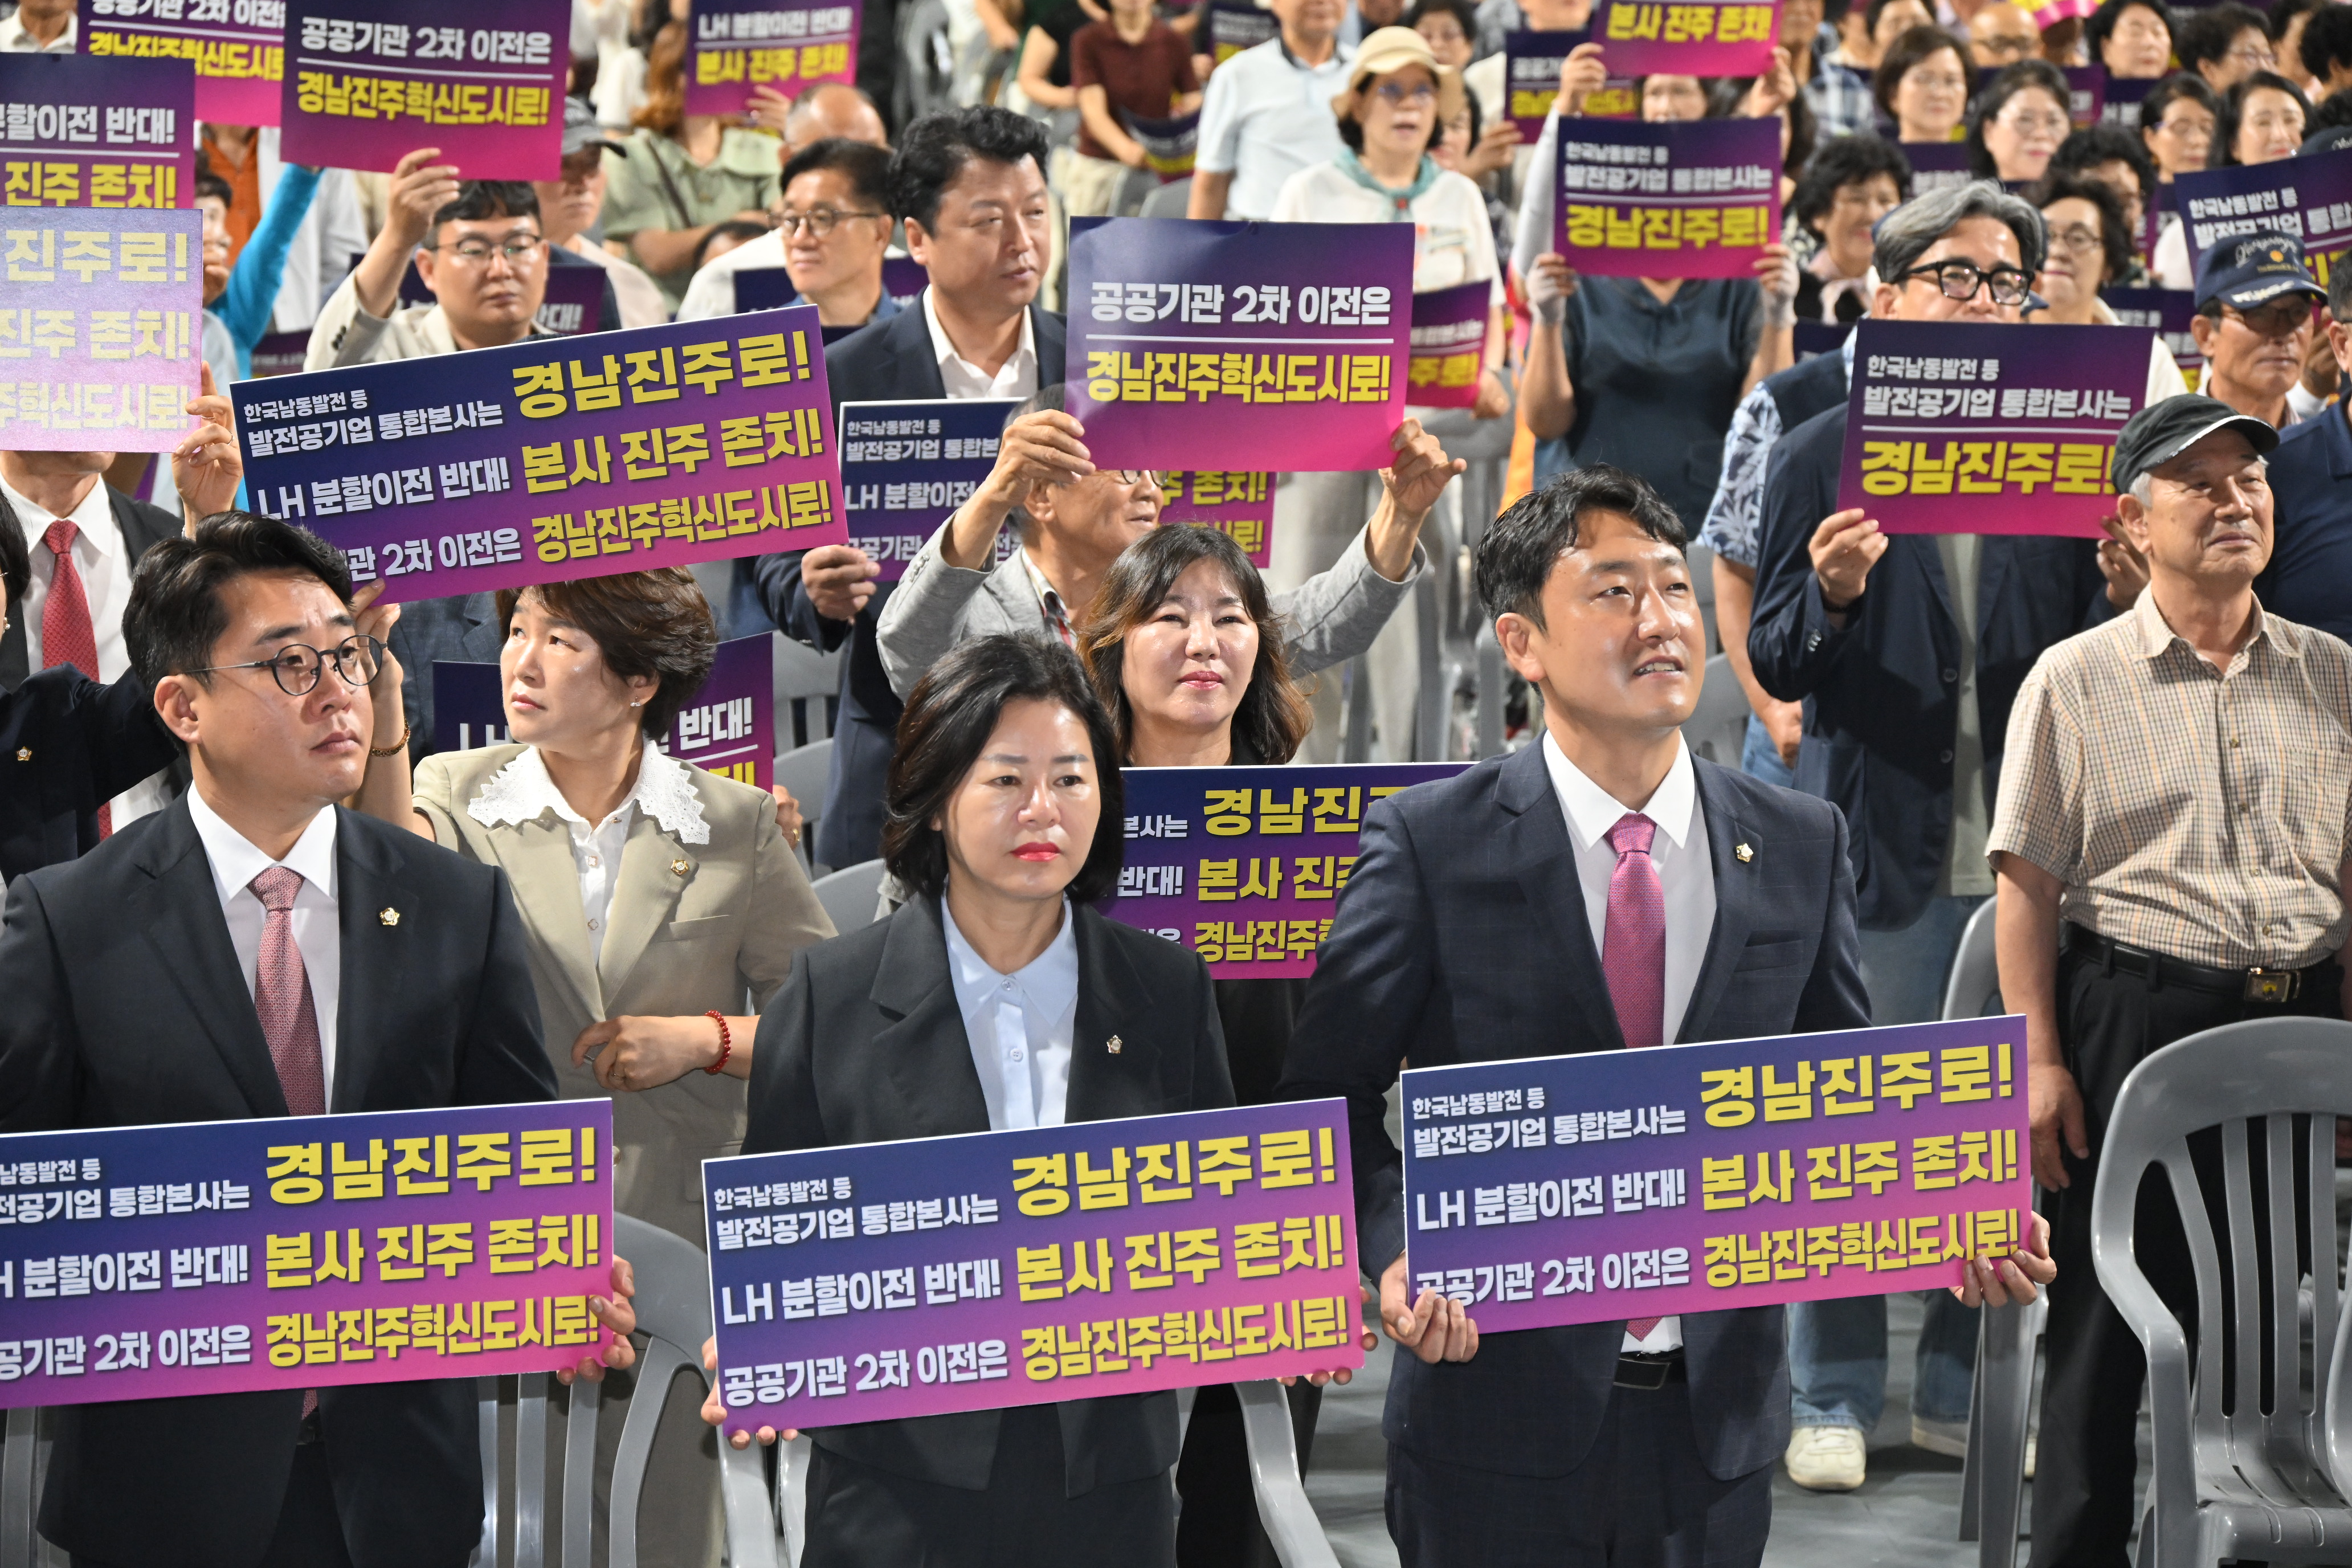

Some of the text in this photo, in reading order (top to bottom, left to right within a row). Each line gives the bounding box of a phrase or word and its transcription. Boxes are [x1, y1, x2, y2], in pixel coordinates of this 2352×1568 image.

[188, 0, 230, 23] 2차
[234, 0, 285, 28] 이전
[90, 32, 284, 80] 경남진주혁신도시
[302, 18, 550, 63] 공공기관 2차 이전은
[0, 103, 174, 144] 할이전 반대!
[299, 72, 549, 124] 경남진주혁신도시로!
[6, 162, 175, 209] 진주 존치!
[1566, 204, 1769, 250] 경남진주로!
[5, 229, 187, 282] 진주로!
[1087, 277, 1390, 328] 공공기관 2차 이전은
[0, 309, 189, 359] 진주 존치!
[513, 331, 810, 422] 경남진주로!
[1088, 352, 1390, 402] 경남진주혁신도시로!
[1868, 356, 1999, 380] 한국남동발전 등
[244, 390, 367, 423] 한국남동발전 등
[847, 419, 940, 436] 한국남동발전 등
[1864, 386, 2130, 419] 발전공기업 통합본사는
[247, 401, 503, 457] 발전공기업 통합본사는
[846, 438, 1001, 462] 발전공기업 통합본
[258, 409, 822, 519] LH 분할이전 반대! 본사 진주 존치!
[1862, 442, 2116, 495] 경남진주로!
[845, 484, 879, 510] LH
[382, 539, 432, 575] 2차
[439, 528, 521, 567] 이전은
[528, 479, 831, 562] 경남진주혁신도시로!
[679, 697, 752, 750] 반대!
[1124, 786, 1408, 839] 본사는 경남진
[1117, 865, 1183, 897] 반대!
[1198, 856, 1282, 900] 본사
[1412, 1087, 1545, 1120] 한국남동발전 등
[1702, 1044, 2011, 1127] 경남진주로!
[1414, 1105, 1685, 1158] 발전공기업 통합본사는
[0, 1159, 100, 1185] 남동발전 등
[267, 1128, 594, 1203] 경남진주로!
[1014, 1128, 1334, 1216] 경남진주로!
[1417, 1130, 2016, 1230] LH 분할이전 반대! 본사 진주 존치!
[110, 1180, 249, 1216] 통합본사는
[714, 1177, 851, 1211] 한국남동발전 등
[717, 1194, 998, 1250] 발전공기업 통합본사는
[23, 1250, 161, 1297] 분할이전
[171, 1245, 247, 1287] 반대!
[267, 1229, 364, 1288] 본사
[377, 1223, 473, 1280] 진주
[489, 1215, 598, 1273] 존치!
[722, 1216, 1342, 1324] LH 분할이전 반대! 본사 진주 존치!
[1542, 1256, 1595, 1295] 2차
[1602, 1247, 1689, 1288] 이전은
[1705, 1209, 2017, 1287] 경남진주혁신도시로!
[95, 1332, 150, 1370] 2차
[158, 1325, 250, 1366] 이전은
[268, 1296, 597, 1366] 경남진주혁신도시로!
[725, 1297, 1347, 1406] 공공기관 2차 이전은 경남진주혁신도시로!
